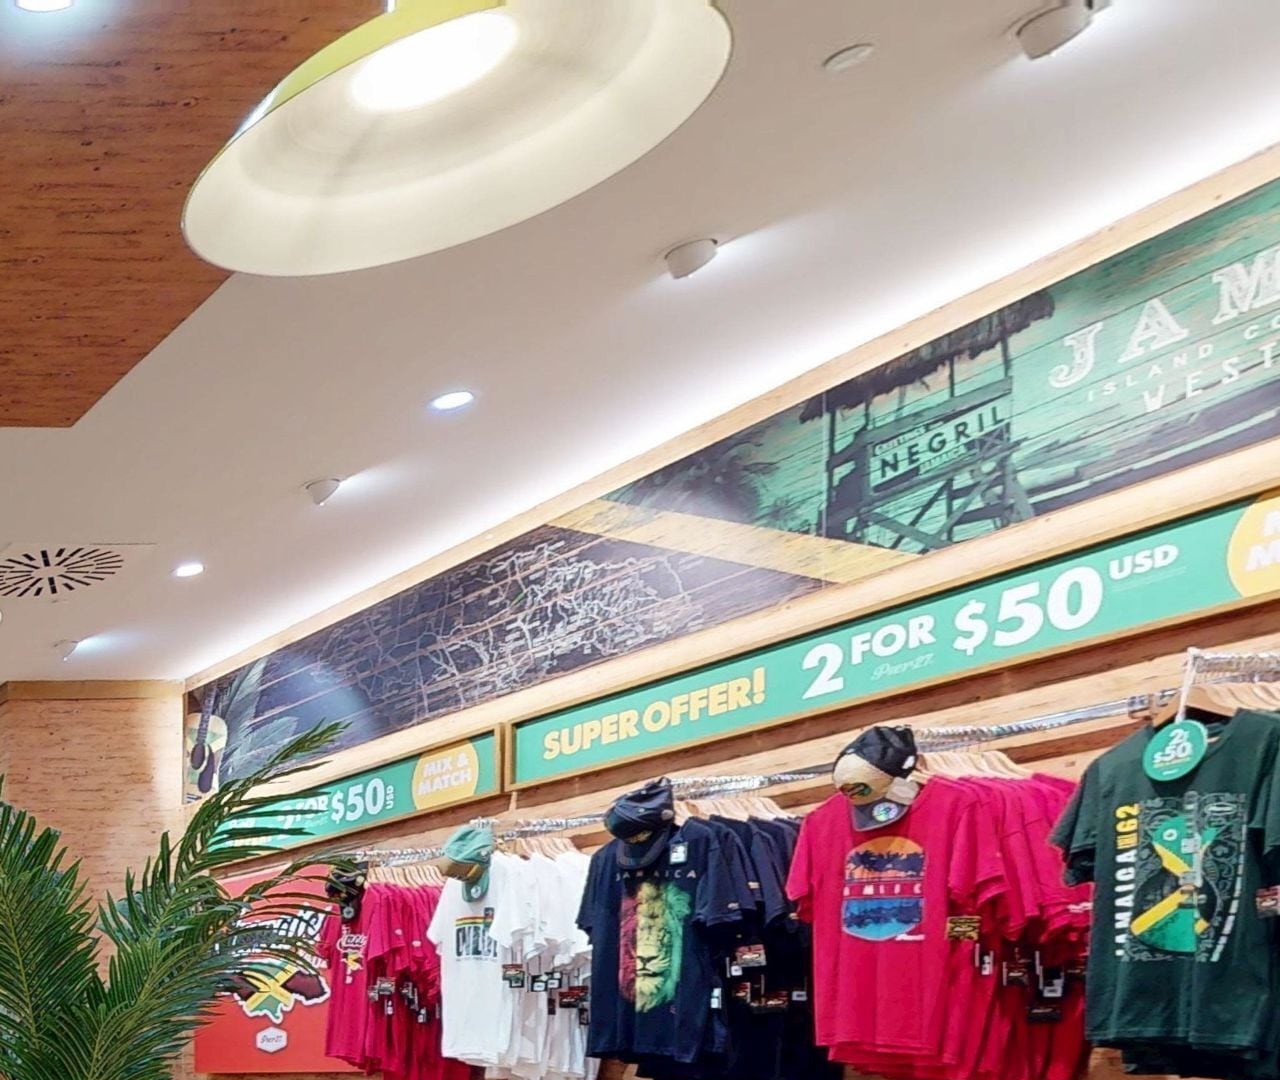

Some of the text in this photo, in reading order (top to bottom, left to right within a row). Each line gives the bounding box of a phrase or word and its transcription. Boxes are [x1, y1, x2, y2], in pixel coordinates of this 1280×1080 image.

[1088, 343, 1214, 401] ISLAND
[881, 406, 1006, 478] NEGRIL
[544, 544, 1180, 761] SUPER OFFER! 2 FOR $50 USD
[418, 770, 472, 795] MATCH
[423, 757, 453, 777] MIX
[331, 778, 385, 824] $50
[385, 785, 395, 809] USD
[1115, 803, 1140, 833] 62
